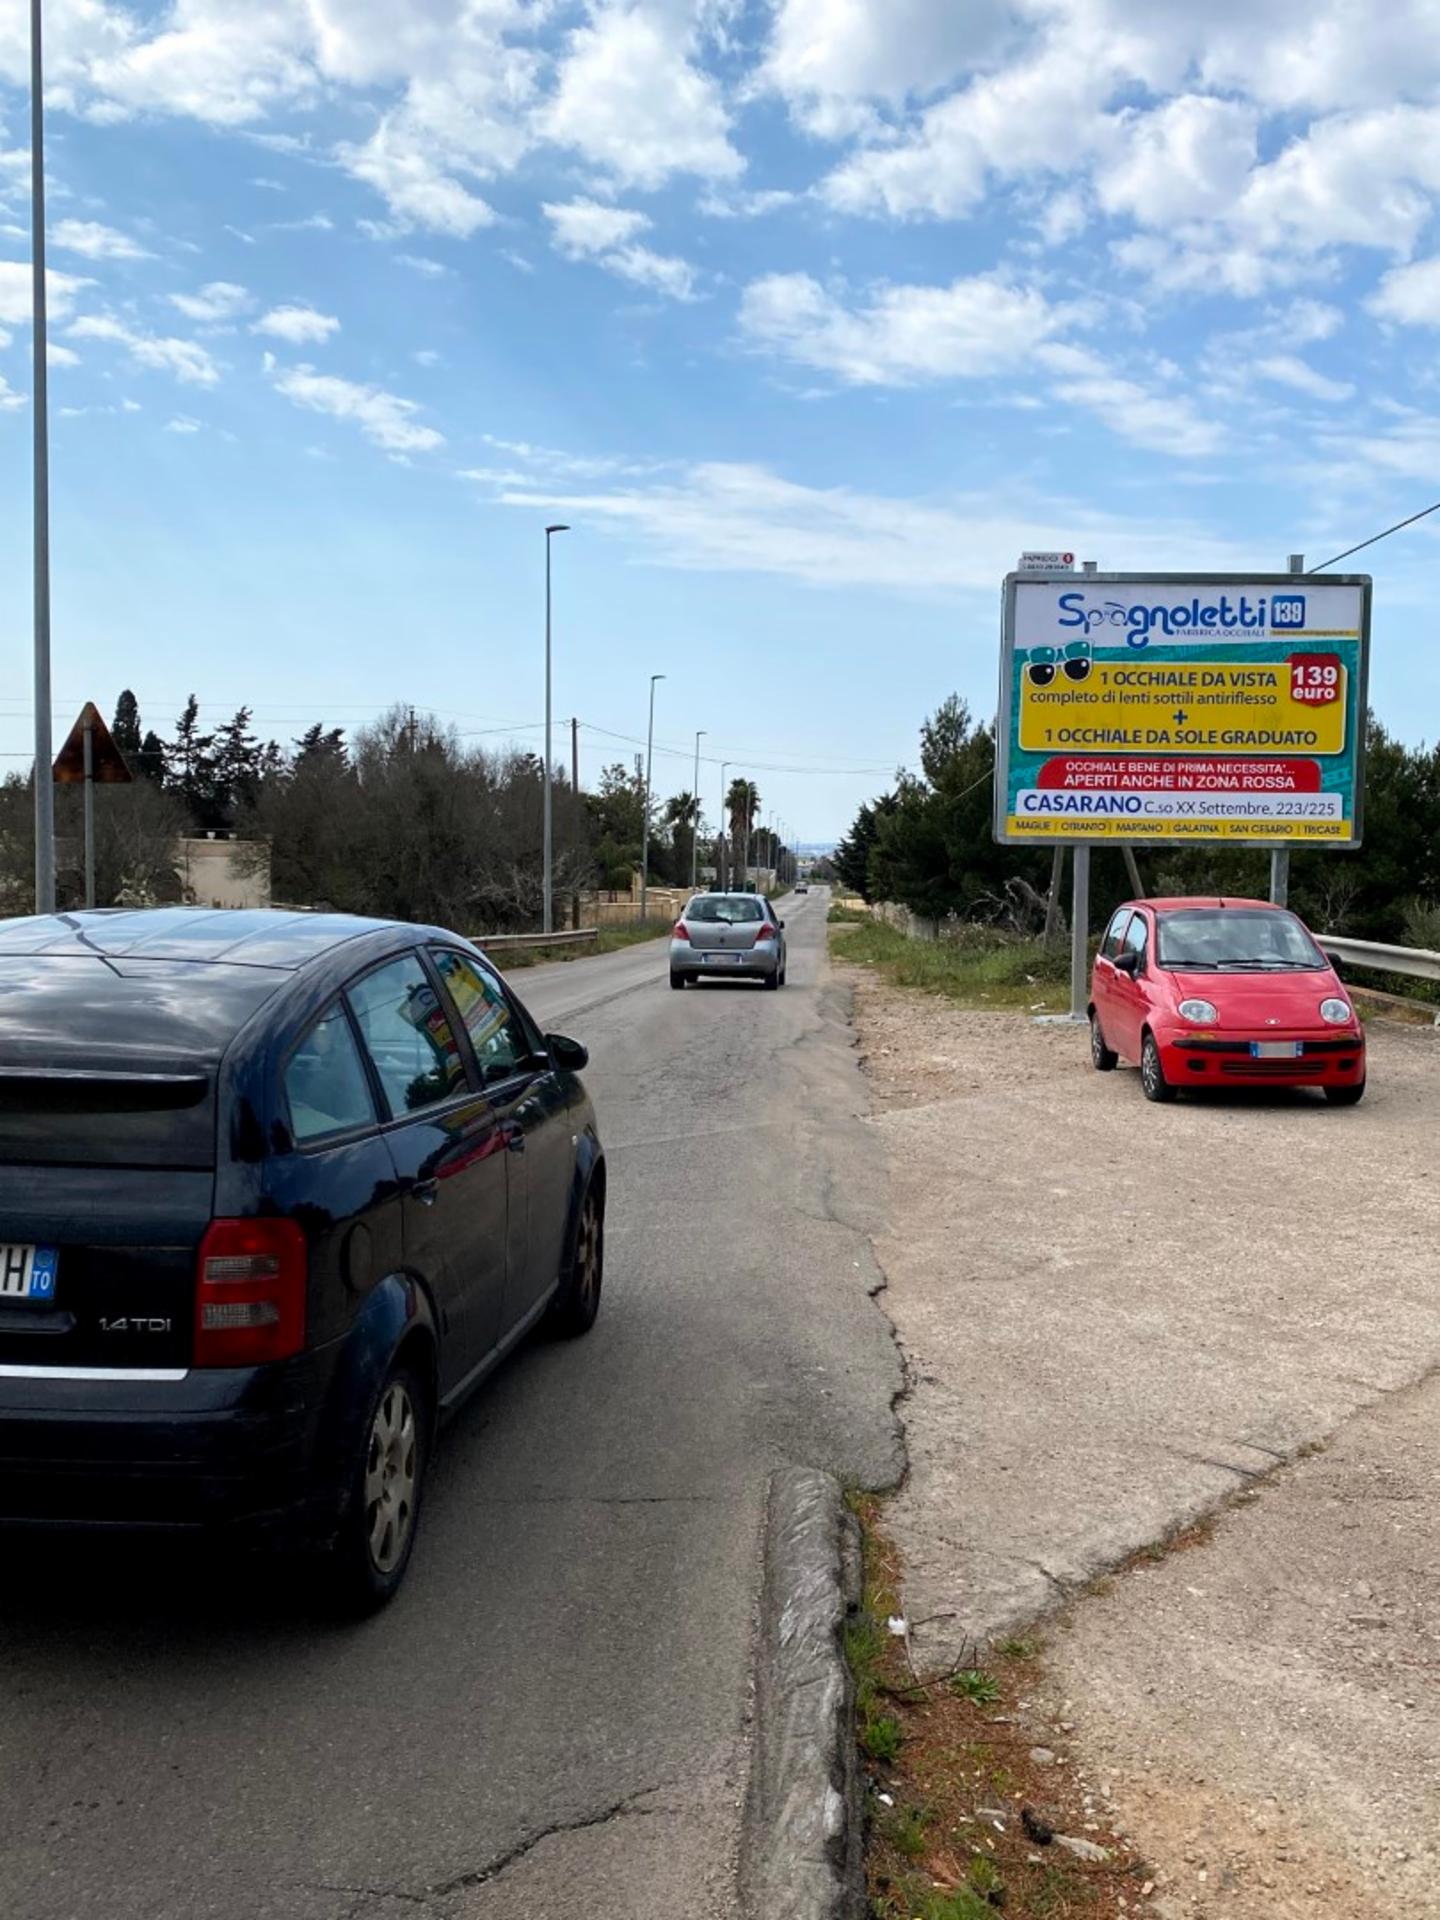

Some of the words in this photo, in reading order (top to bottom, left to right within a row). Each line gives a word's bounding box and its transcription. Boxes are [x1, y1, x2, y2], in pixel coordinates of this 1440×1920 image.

[1058, 593, 1266, 649] Spagnoletti
[1100, 671, 1108, 685] 1
[1113, 671, 1197, 686] OCCHIALE
[1201, 672, 1226, 687] DA
[1229, 673, 1277, 687] VISTA
[1292, 665, 1338, 686] 139
[1030, 689, 1099, 706] completo
[1102, 690, 1116, 704] di
[1119, 690, 1150, 704] lenti
[1153, 690, 1194, 705] sottili
[1197, 691, 1277, 705] antiriflesso
[1292, 687, 1336, 700] euro
[1044, 729, 1052, 742] 1
[1057, 728, 1142, 743] OCCHIALE
[1146, 729, 1171, 744] DA
[1174, 730, 1217, 745] SOLE
[1221, 730, 1317, 745] GRADUATO
[1066, 762, 1126, 772] OCCHIALE
[1128, 762, 1161, 772] BENE
[1163, 763, 1176, 773] DI
[1178, 763, 1216, 774] PRIMA
[1064, 774, 1118, 787] APERTI
[1121, 775, 1175, 788] ANCHE
[1178, 775, 1193, 788] IN
[1195, 776, 1241, 788] ZONA
[1242, 776, 1296, 789] ROSSA
[1023, 794, 1142, 813] CASARANO
[1144, 801, 1173, 814] C.so
[1176, 802, 1196, 814] XX
[1276, 802, 1336, 816] 223/225
[1015, 821, 1051, 830] MAGLIE
[1061, 822, 1106, 831] OTRANTO
[1116, 823, 1163, 832] MARTANO
[1173, 824, 1219, 833] GALATINA
[1229, 824, 1245, 833] SAN
[1251, 825, 1294, 834] CESARIO
[1304, 825, 1341, 834] TRICASE
[0, 1247, 28, 1291] H
[32, 1271, 51, 1290] TO
[99, 1318, 129, 1331] 1.4
[130, 1318, 172, 1331] TDI
